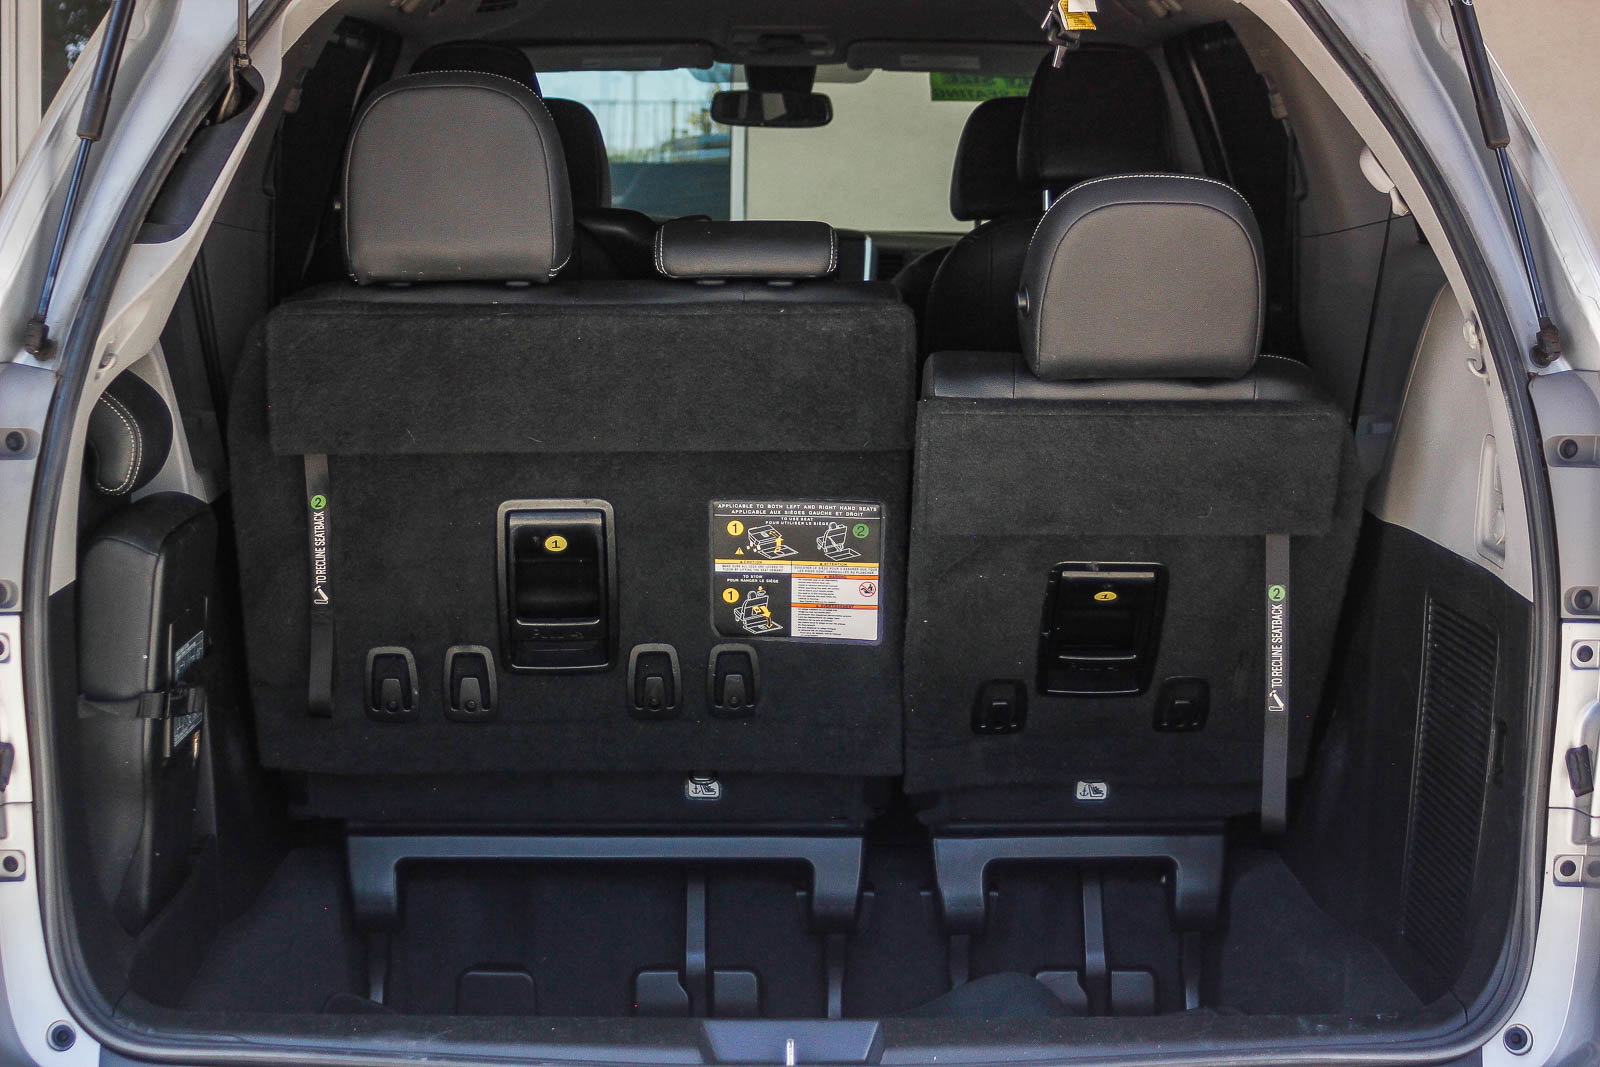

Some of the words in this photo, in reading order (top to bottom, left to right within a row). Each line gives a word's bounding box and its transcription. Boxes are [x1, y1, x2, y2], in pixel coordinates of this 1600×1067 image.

[314, 511, 325, 546] SEATBACK
[315, 548, 326, 575] RECLINE
[316, 576, 327, 584] TO
[1272, 604, 1283, 643] SEATBACK
[1272, 644, 1283, 676] RECLINE
[1272, 678, 1283, 688] TO
